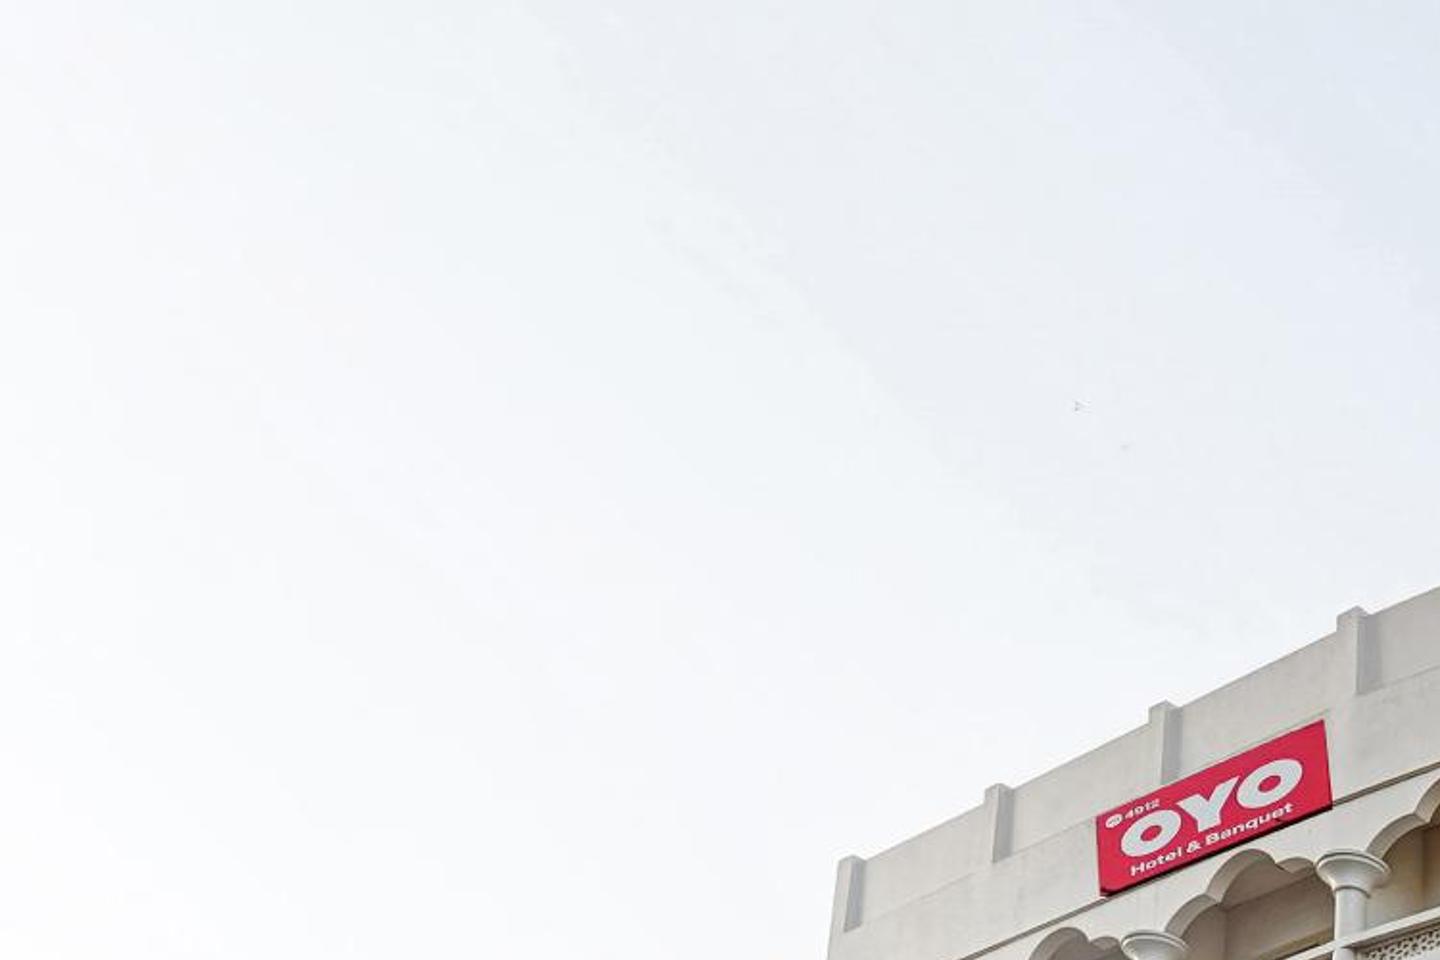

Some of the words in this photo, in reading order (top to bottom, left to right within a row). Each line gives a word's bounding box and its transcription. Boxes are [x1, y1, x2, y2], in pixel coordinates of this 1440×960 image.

[1120, 758, 1303, 858] OYO
[1130, 846, 1182, 876] Hotel
[1186, 840, 1201, 853] &
[1205, 802, 1294, 845] Banquet
